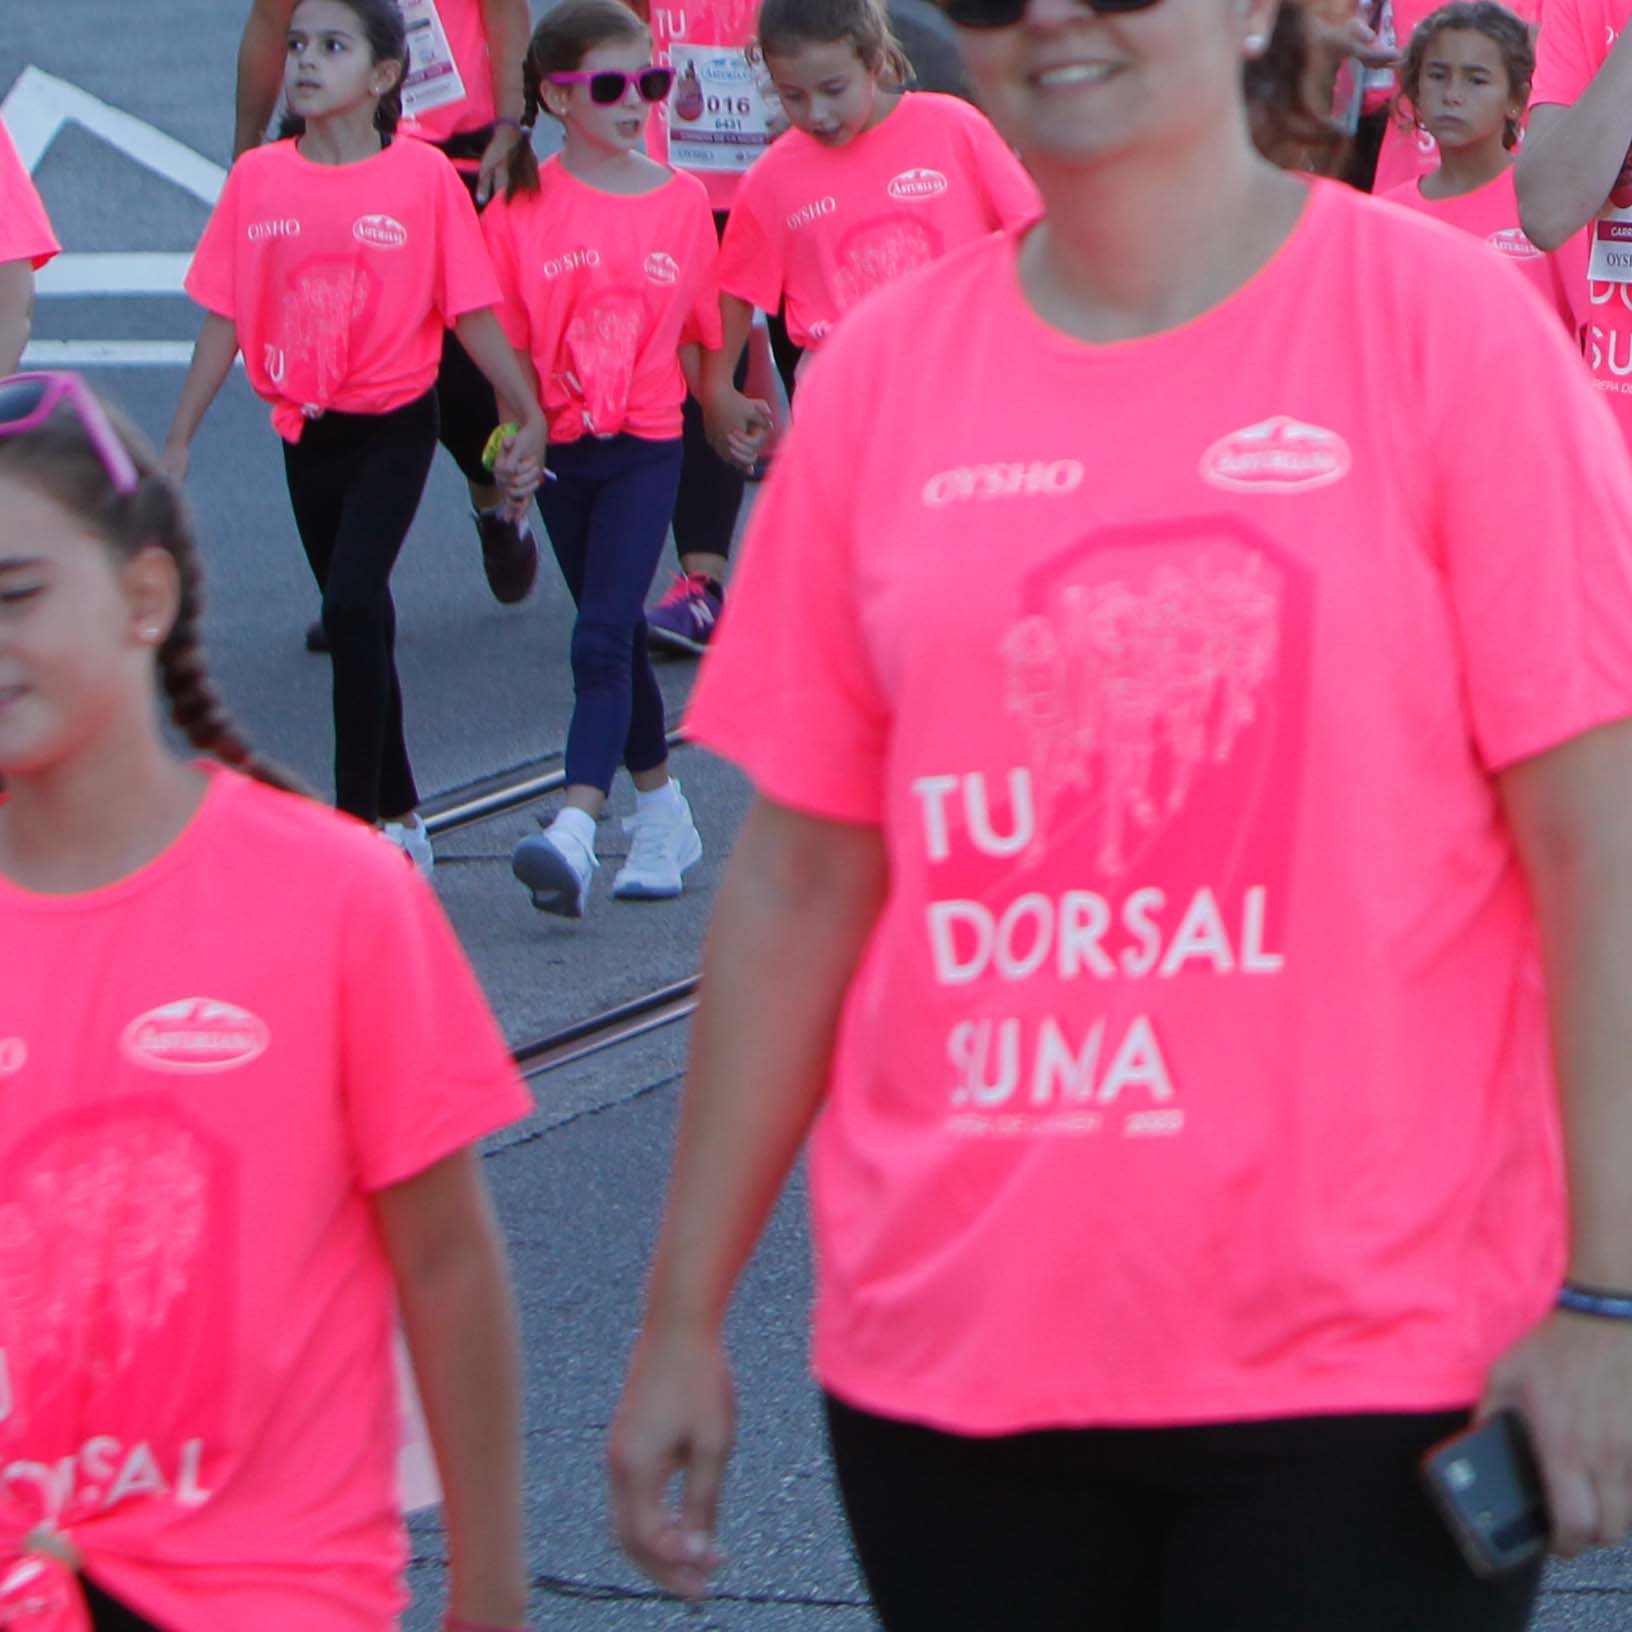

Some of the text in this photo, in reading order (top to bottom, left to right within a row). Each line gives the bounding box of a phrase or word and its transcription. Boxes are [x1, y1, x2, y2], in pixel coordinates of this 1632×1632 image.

[656, 9, 686, 37] TU
[707, 95, 751, 116] 016
[248, 219, 301, 240] OYSHO
[544, 250, 600, 279] OYSHO
[922, 458, 1084, 508] OYSHO
[912, 768, 1034, 862] TU
[926, 885, 1285, 985] DORSAL
